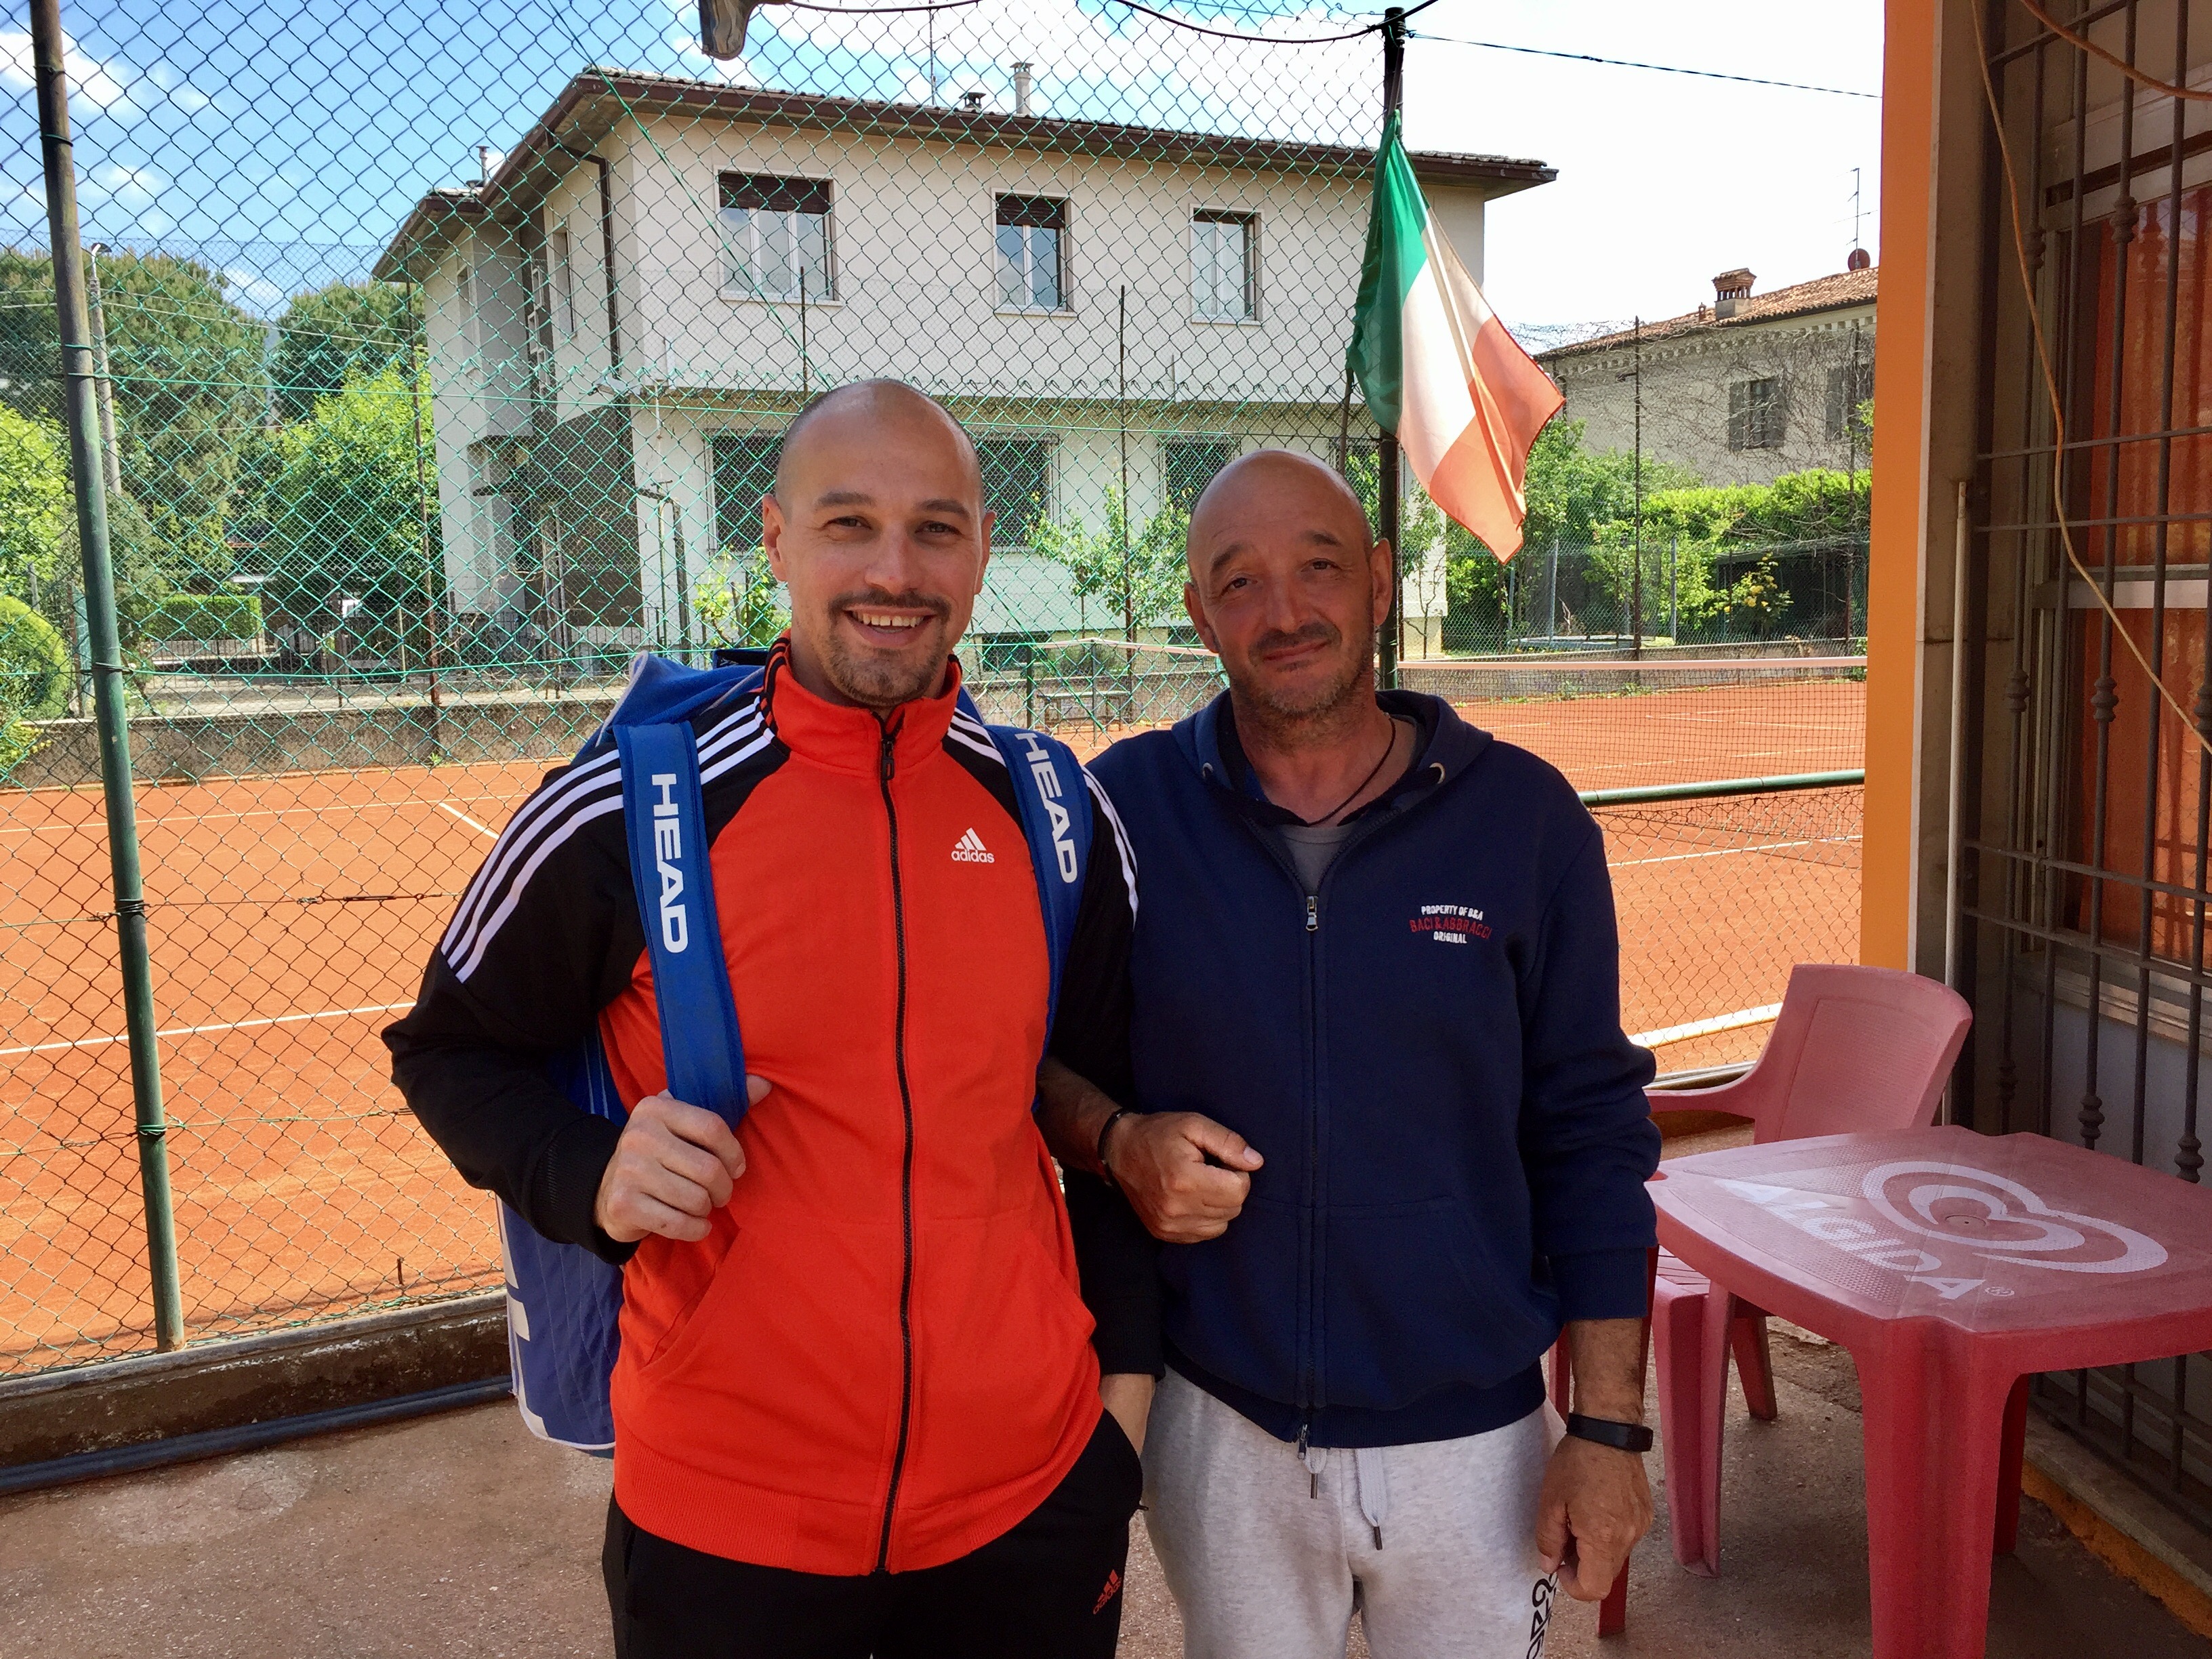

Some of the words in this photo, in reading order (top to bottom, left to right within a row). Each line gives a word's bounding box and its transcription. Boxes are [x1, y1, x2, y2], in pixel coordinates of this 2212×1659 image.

[1015, 733, 1078, 883] HEAD
[951, 848, 995, 863] adidas
[652, 773, 689, 954] HEAD
[1421, 905, 1458, 915] PROPERTY
[1458, 906, 1469, 916] OF
[1433, 931, 1467, 943] ORIGINAL
